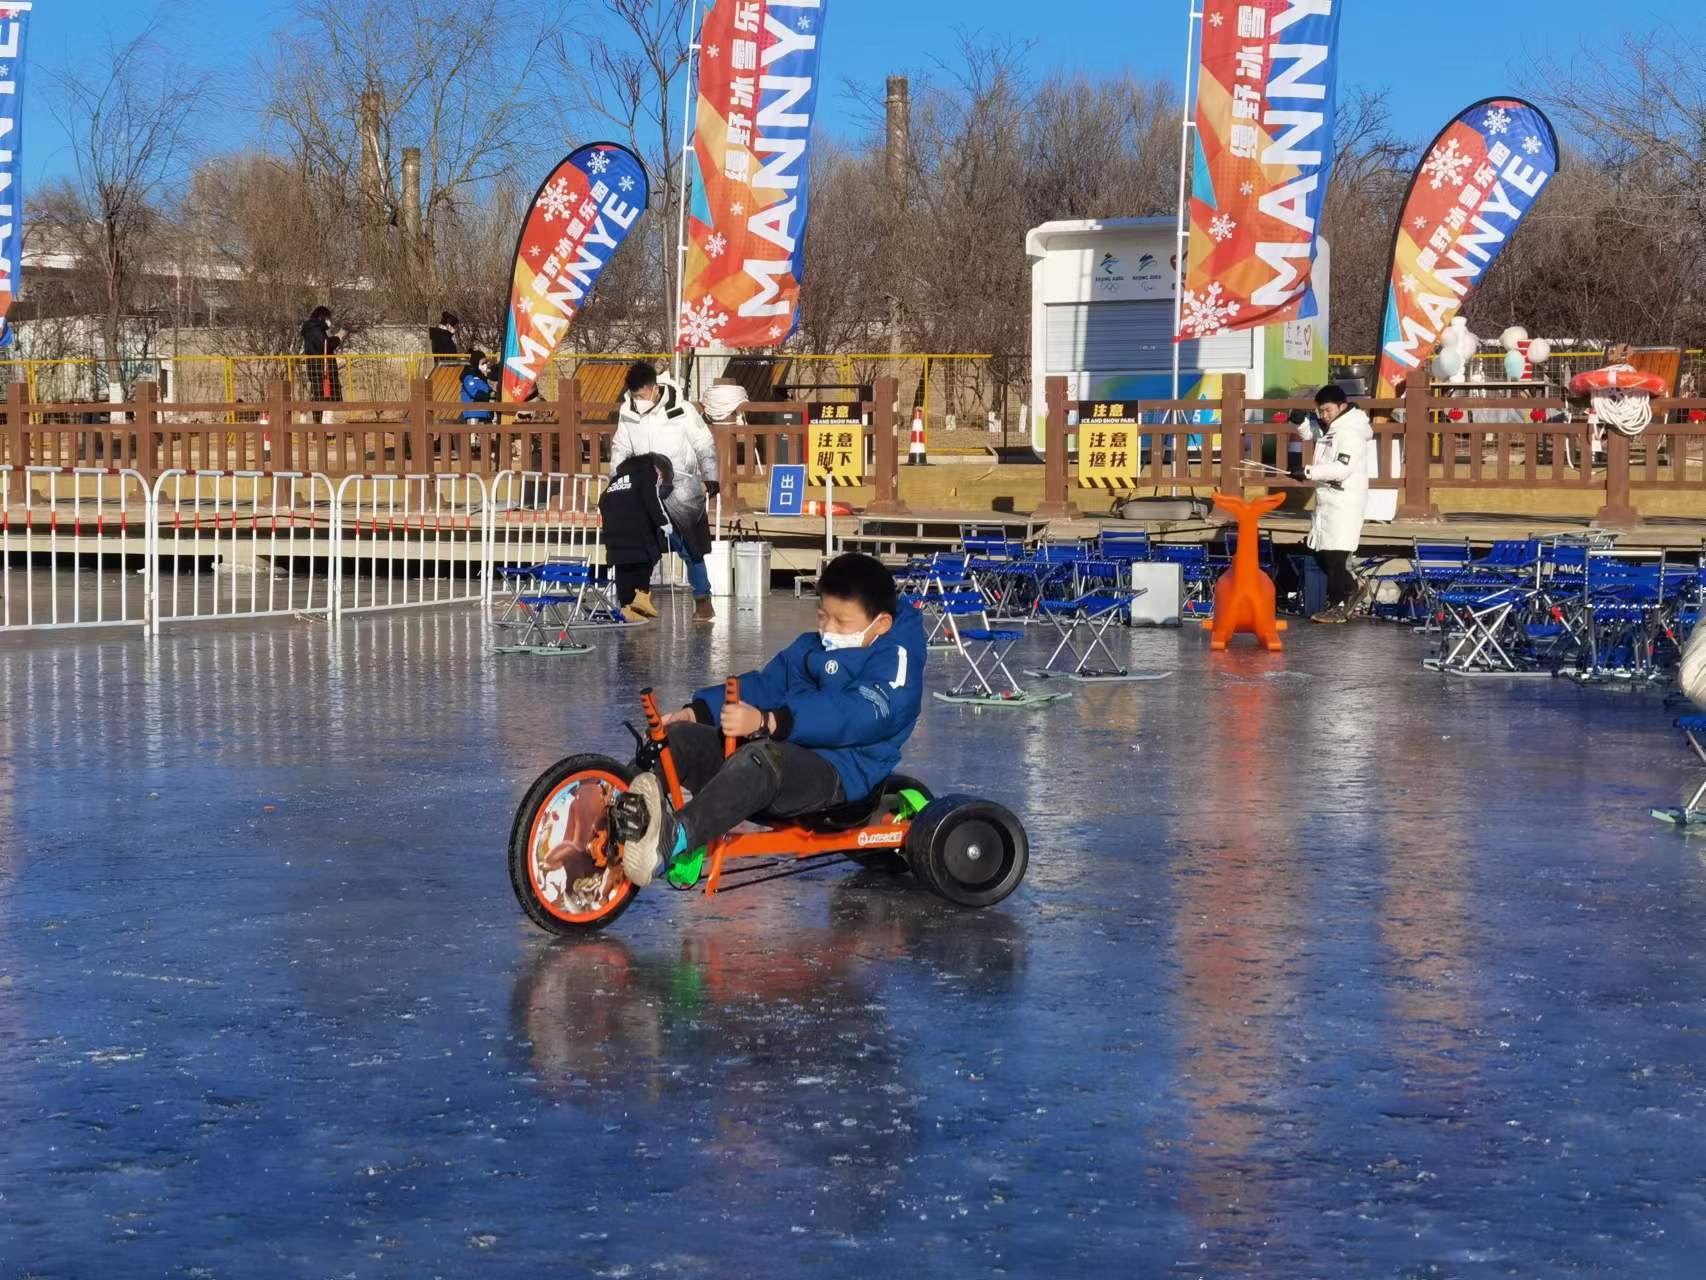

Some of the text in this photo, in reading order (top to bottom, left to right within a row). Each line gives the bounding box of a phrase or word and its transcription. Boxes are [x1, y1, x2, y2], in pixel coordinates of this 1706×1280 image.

[1384, 155, 1547, 368] MANNYE
[506, 192, 639, 382] MANNYE
[821, 405, 849, 418] 注意
[1093, 404, 1124, 417] 注意
[818, 432, 853, 448] 注意
[1089, 432, 1128, 448] 注意
[817, 451, 853, 466] 脚下
[606, 482, 632, 493] adidas
[779, 474, 794, 506] 出口
